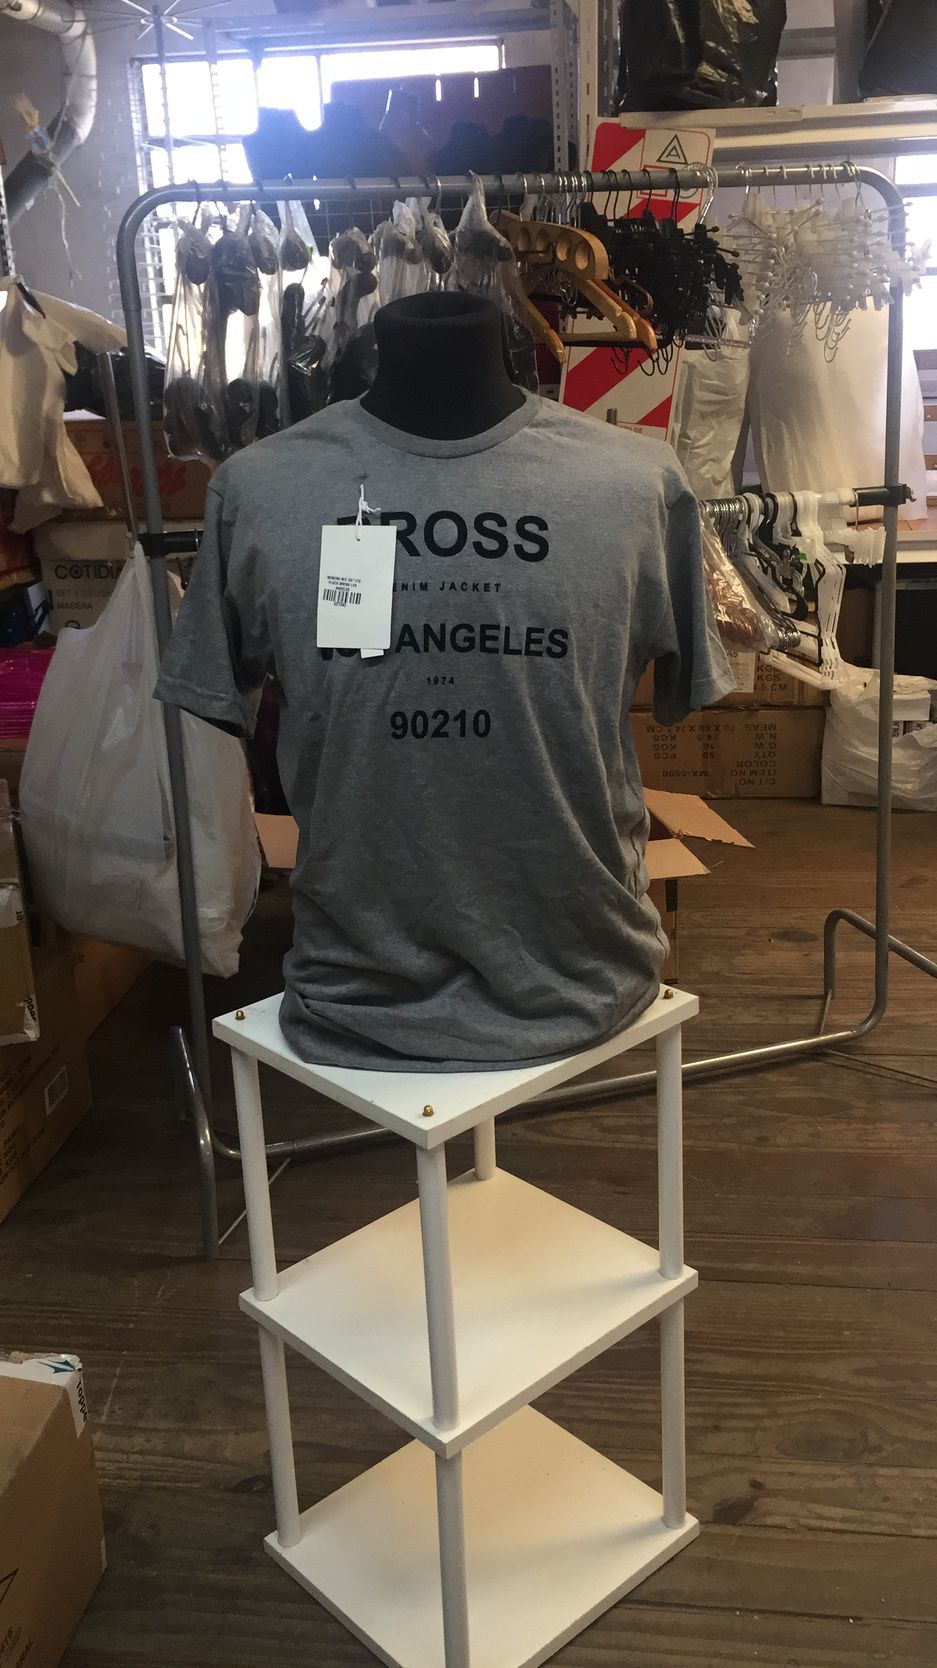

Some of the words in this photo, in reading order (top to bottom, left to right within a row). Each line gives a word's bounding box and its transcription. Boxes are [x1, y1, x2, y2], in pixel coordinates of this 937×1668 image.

[337, 510, 550, 563] ROSS
[393, 582, 428, 592] ENIM
[439, 582, 502, 593] JACKET
[394, 623, 569, 659] ANGELES
[426, 676, 455, 685] 1974
[756, 673, 782, 682] KGS
[390, 709, 491, 740] 90210
[646, 725, 664, 733] CM
[653, 734, 677, 742] KGS
[653, 743, 677, 751] KGS
[654, 752, 677, 760] PCS
[753, 752, 776, 760] QTY
[735, 760, 776, 769] COLOR
[730, 769, 746, 777] NO
[750, 769, 776, 778] ITEM
